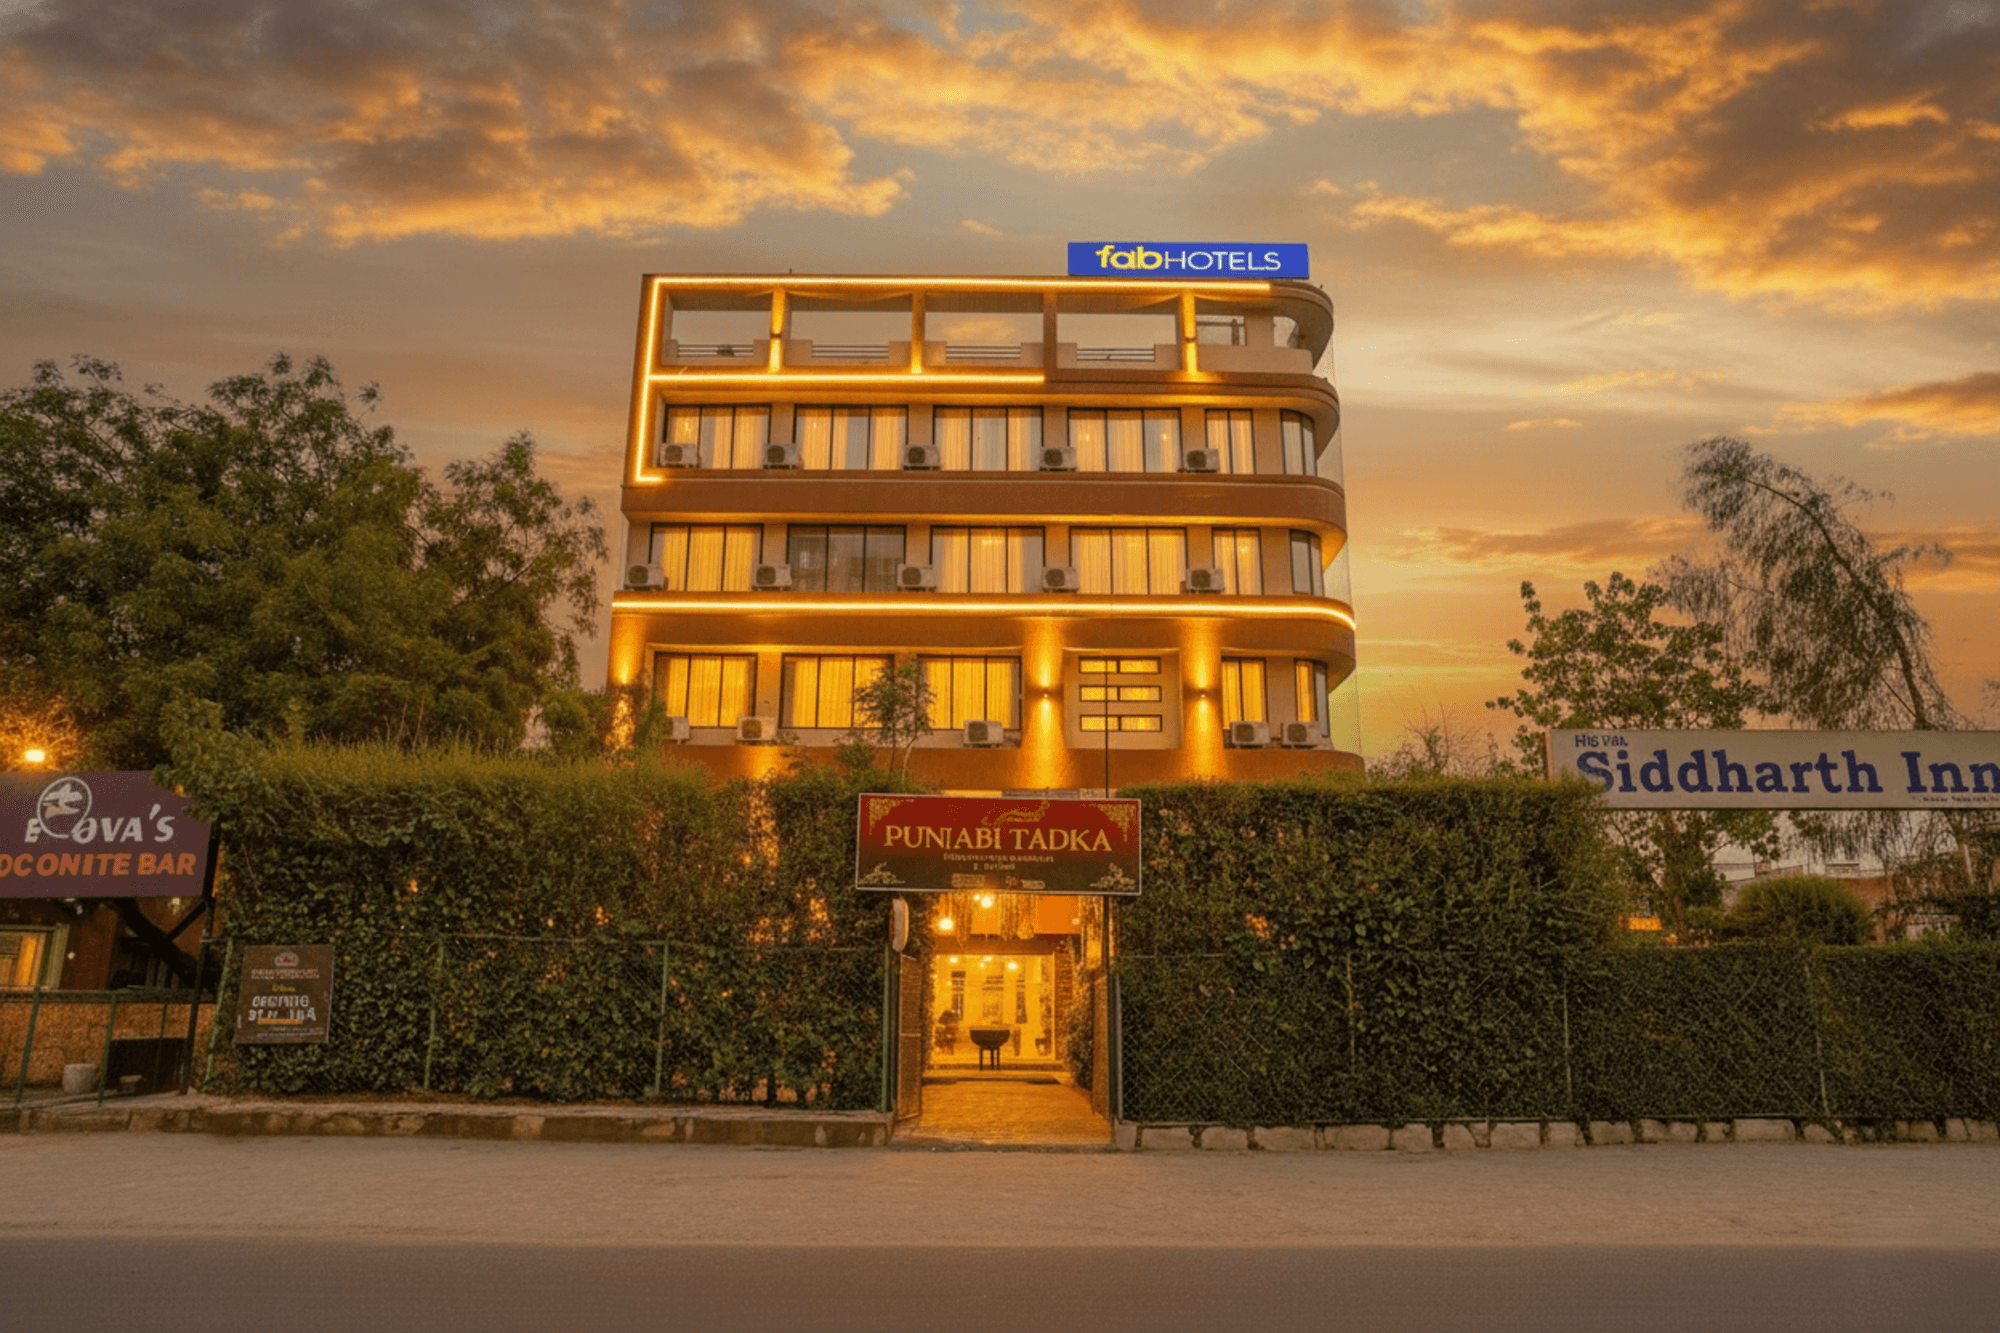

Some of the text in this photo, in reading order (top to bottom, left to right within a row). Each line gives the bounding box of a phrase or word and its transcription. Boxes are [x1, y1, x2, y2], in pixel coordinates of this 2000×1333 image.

[1096, 244, 1282, 271] fabHOTELS
[1576, 749, 2000, 793] Siddharth Inn
[1008, 827, 1113, 852] TADKA
[137, 852, 197, 876] BAR
